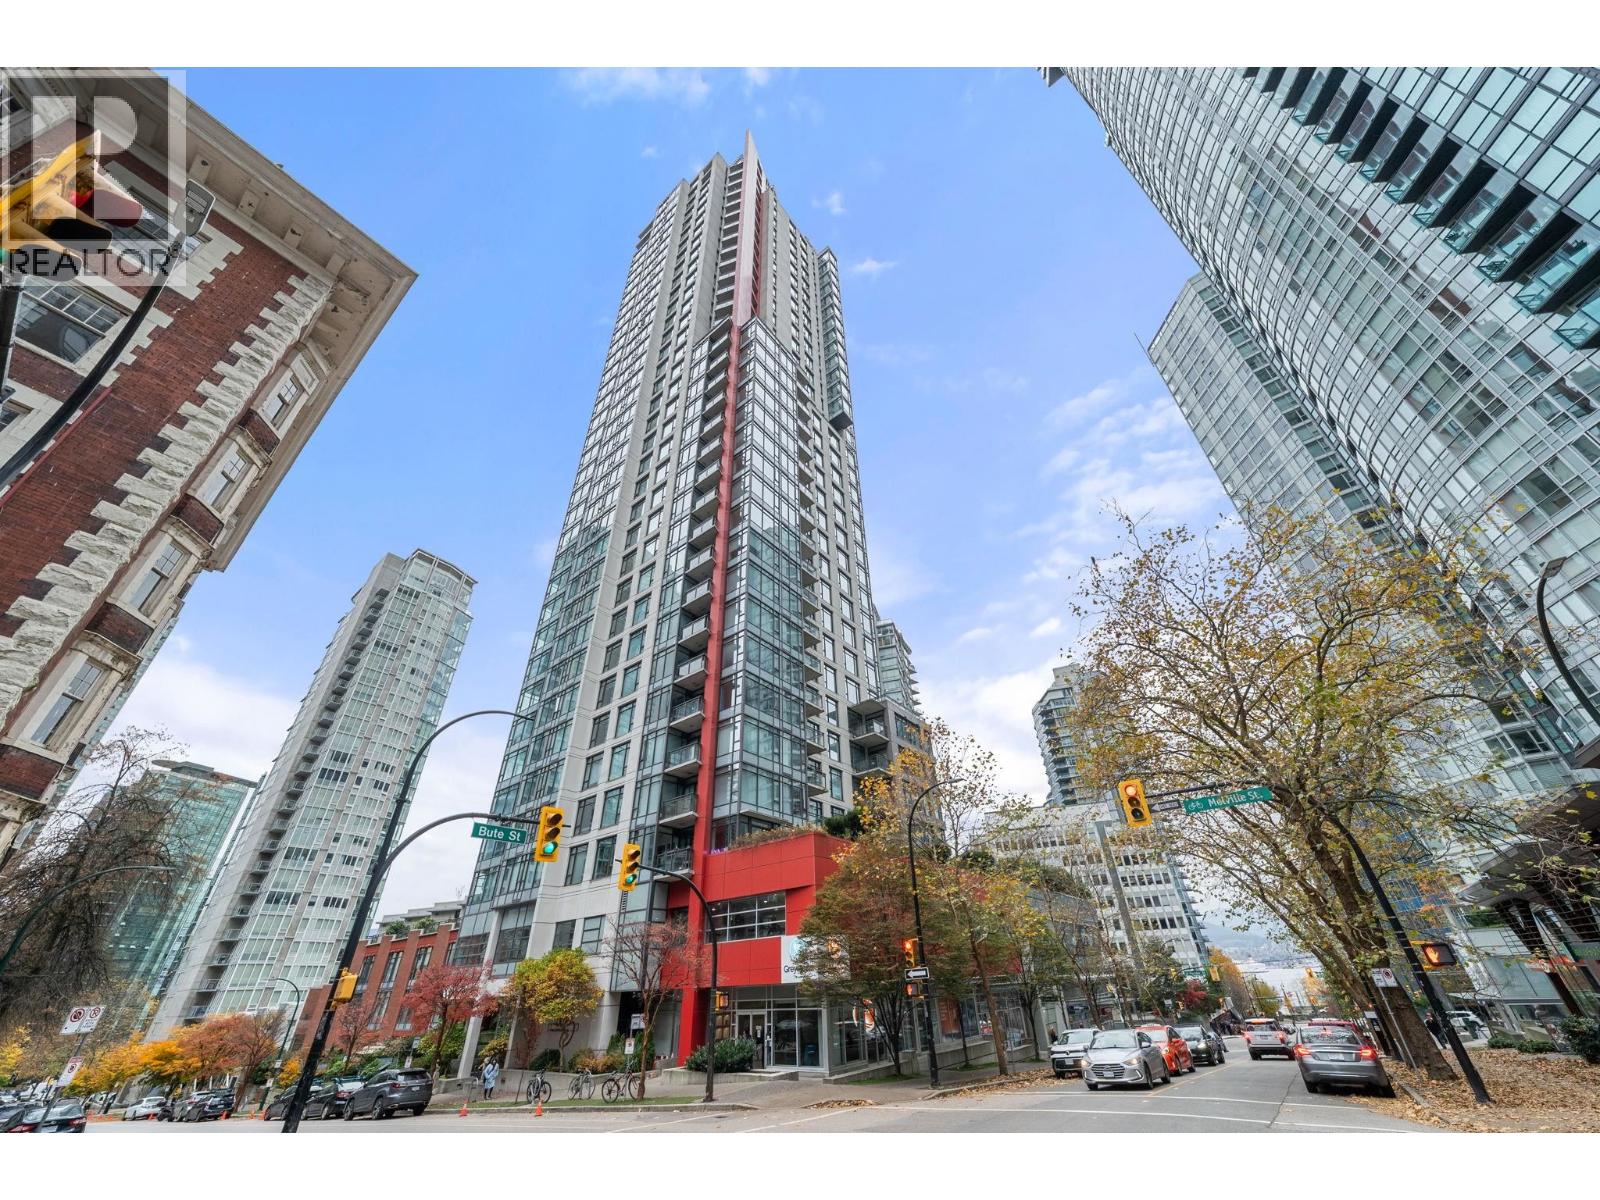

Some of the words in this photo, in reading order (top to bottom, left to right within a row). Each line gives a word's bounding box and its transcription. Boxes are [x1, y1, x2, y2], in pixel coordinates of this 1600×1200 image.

[1208, 793, 1246, 807] Melville
[478, 826, 504, 839] Bute
[508, 830, 521, 842] St
